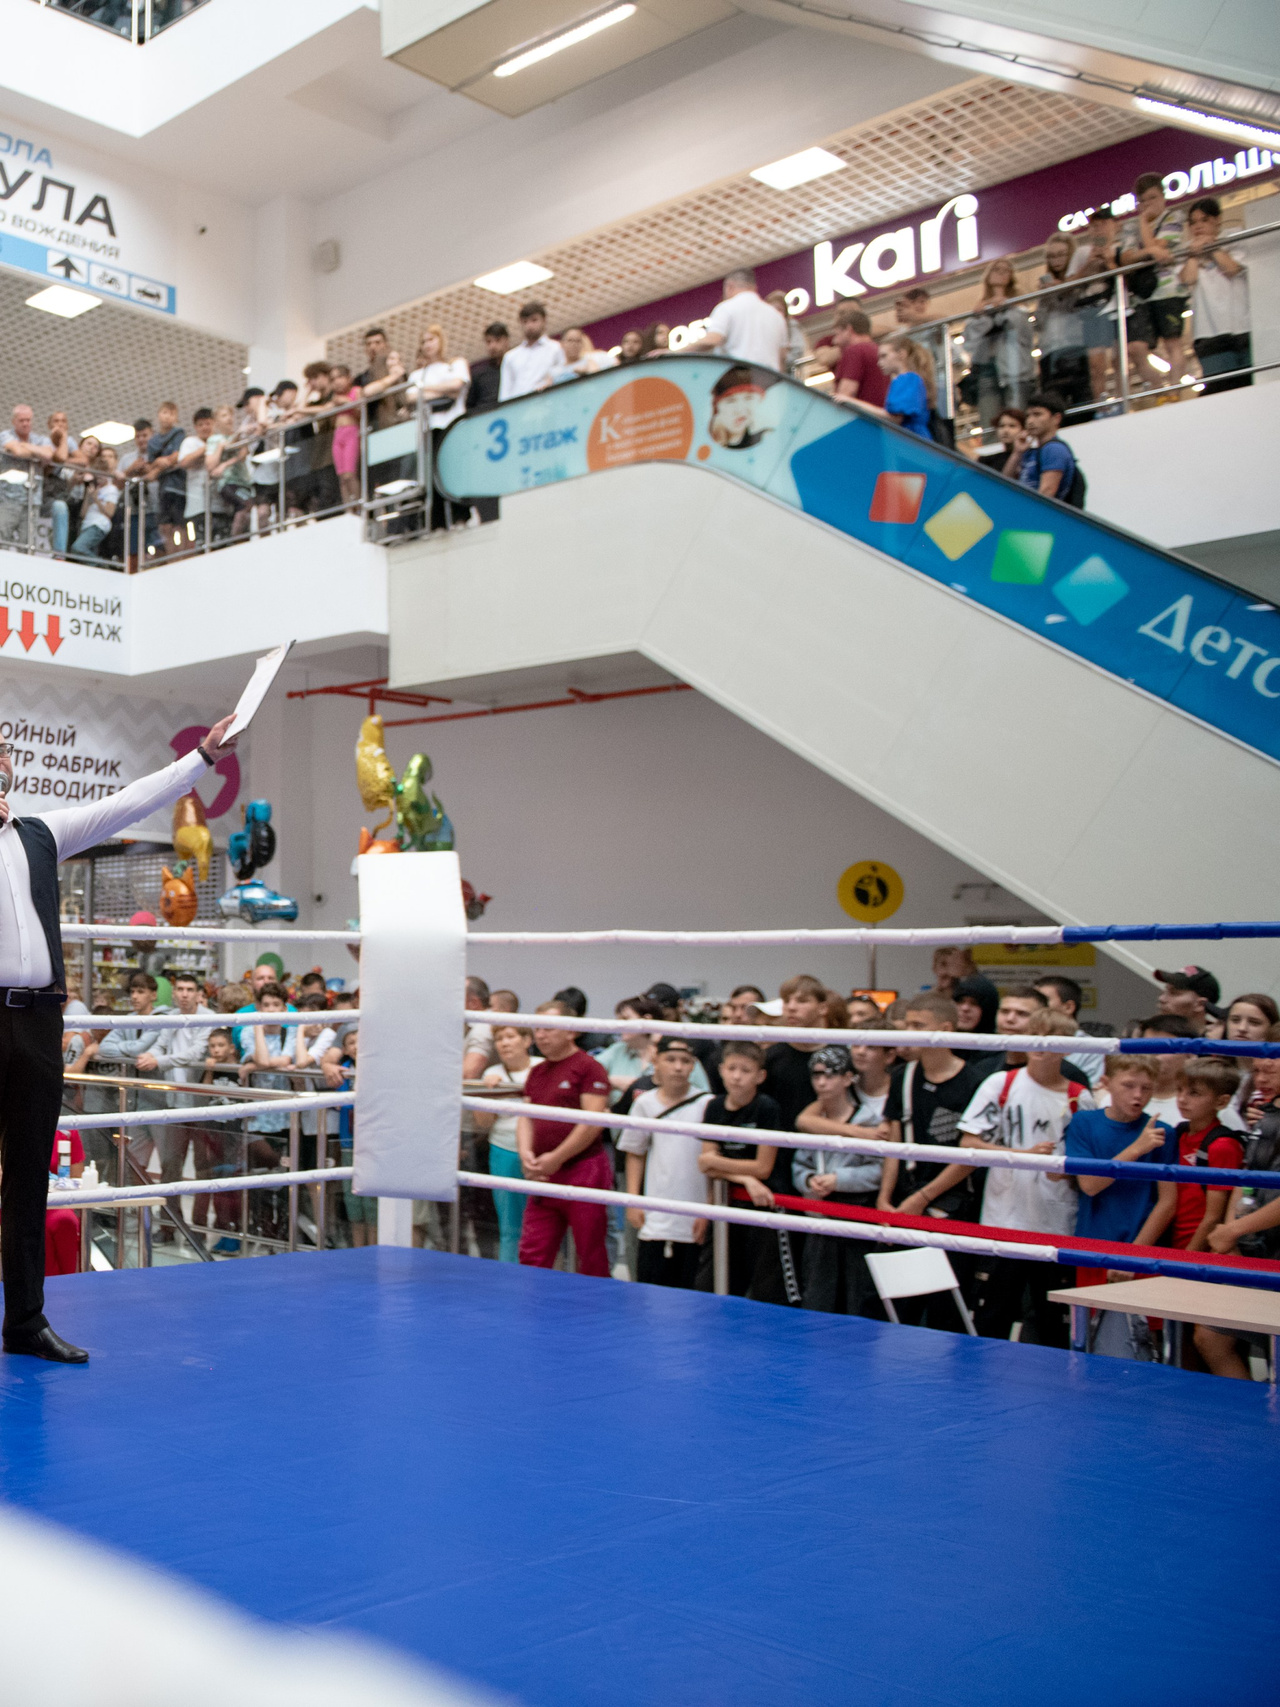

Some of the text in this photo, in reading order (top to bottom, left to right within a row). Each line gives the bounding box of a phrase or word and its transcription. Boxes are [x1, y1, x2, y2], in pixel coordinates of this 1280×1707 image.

[1161, 146, 1280, 200] ОЛЬШ
[11, 214, 121, 260] ВОЖДЕНИЯ
[814, 194, 979, 308] kari
[486, 418, 510, 462] 3
[519, 425, 578, 456] этаж
[69, 618, 122, 643] ЭТАЖ
[1136, 593, 1280, 698] Детс
[42, 753, 122, 777] ФАБРИК
[13, 775, 127, 801] ИЗВОДИТЕ
